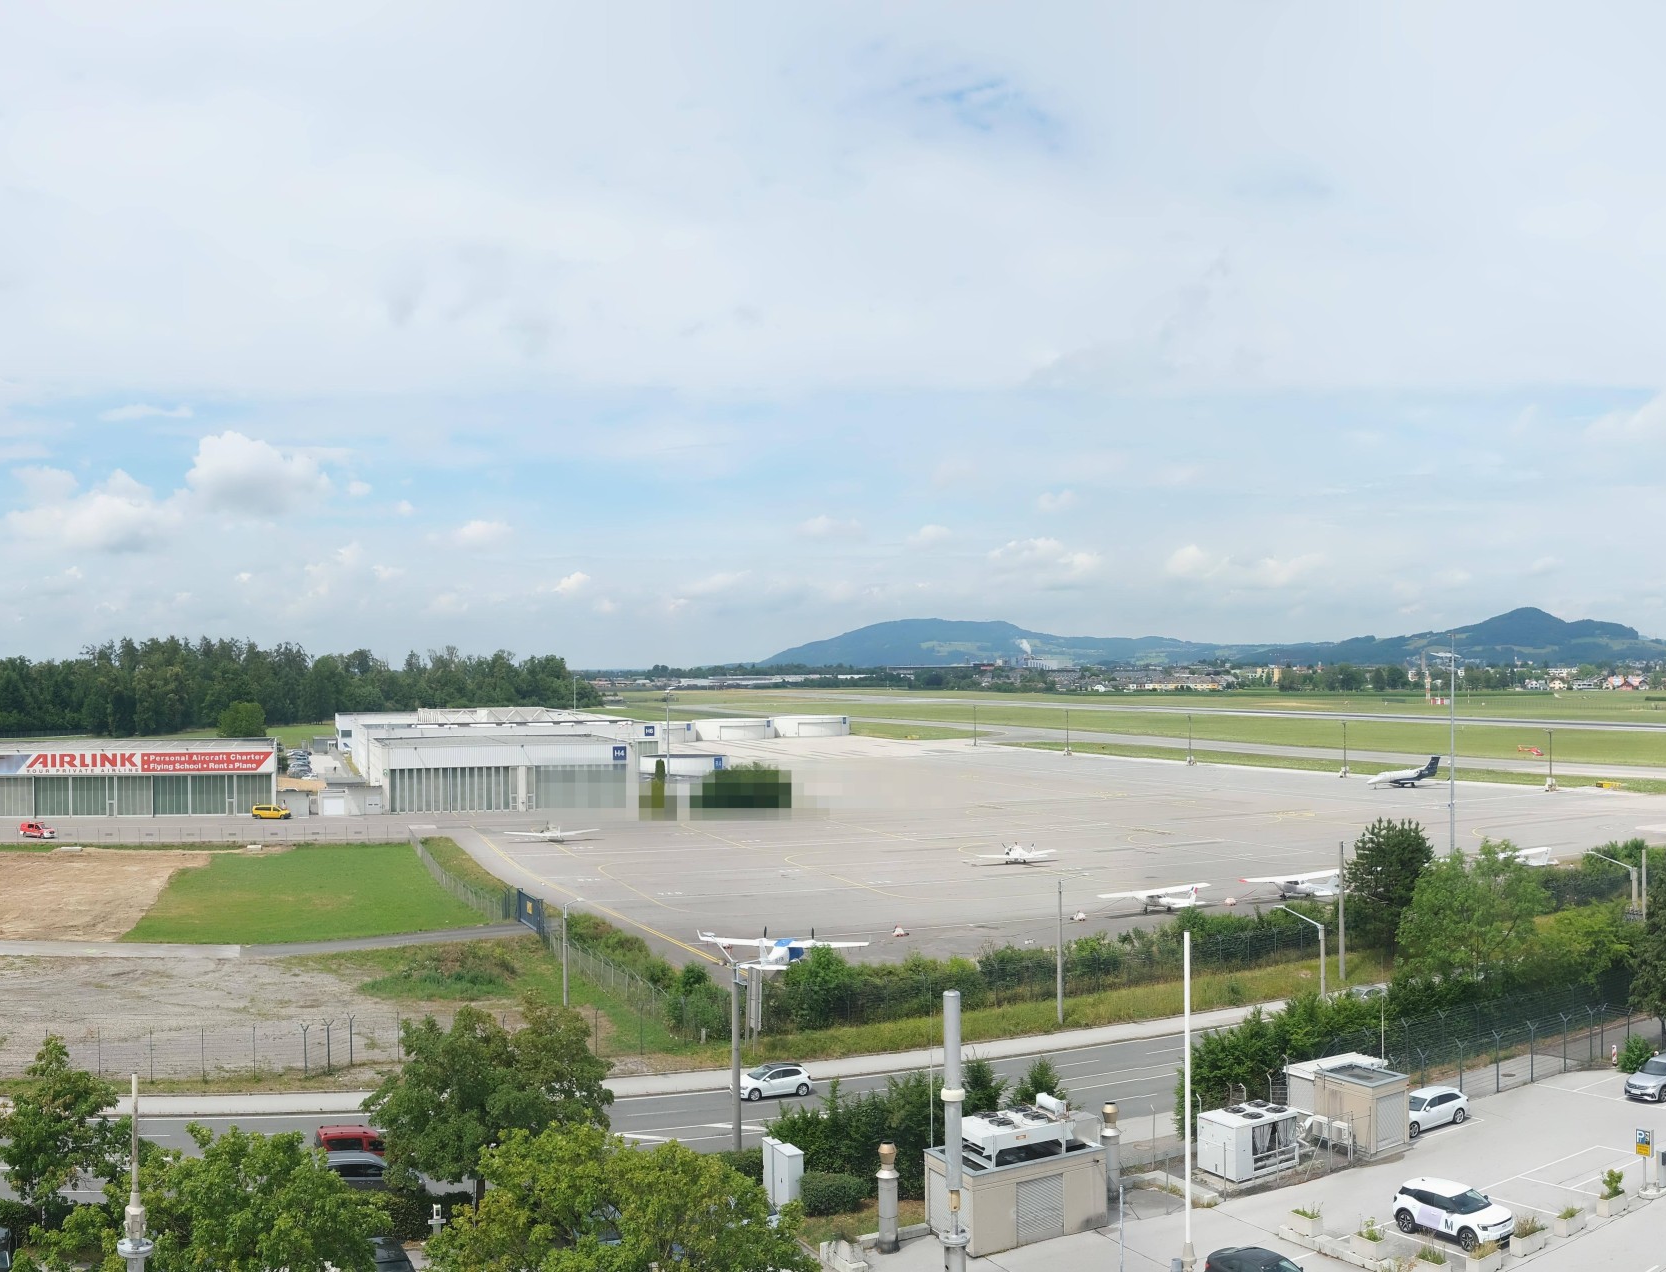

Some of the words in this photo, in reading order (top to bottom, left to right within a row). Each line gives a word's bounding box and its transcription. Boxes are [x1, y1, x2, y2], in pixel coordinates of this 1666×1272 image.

[230, 753, 264, 761] Charter
[614, 749, 625, 757] H4
[27, 753, 138, 769] AIRLINK
[1637, 1130, 1645, 1142] P
[1444, 1218, 1454, 1232] M
